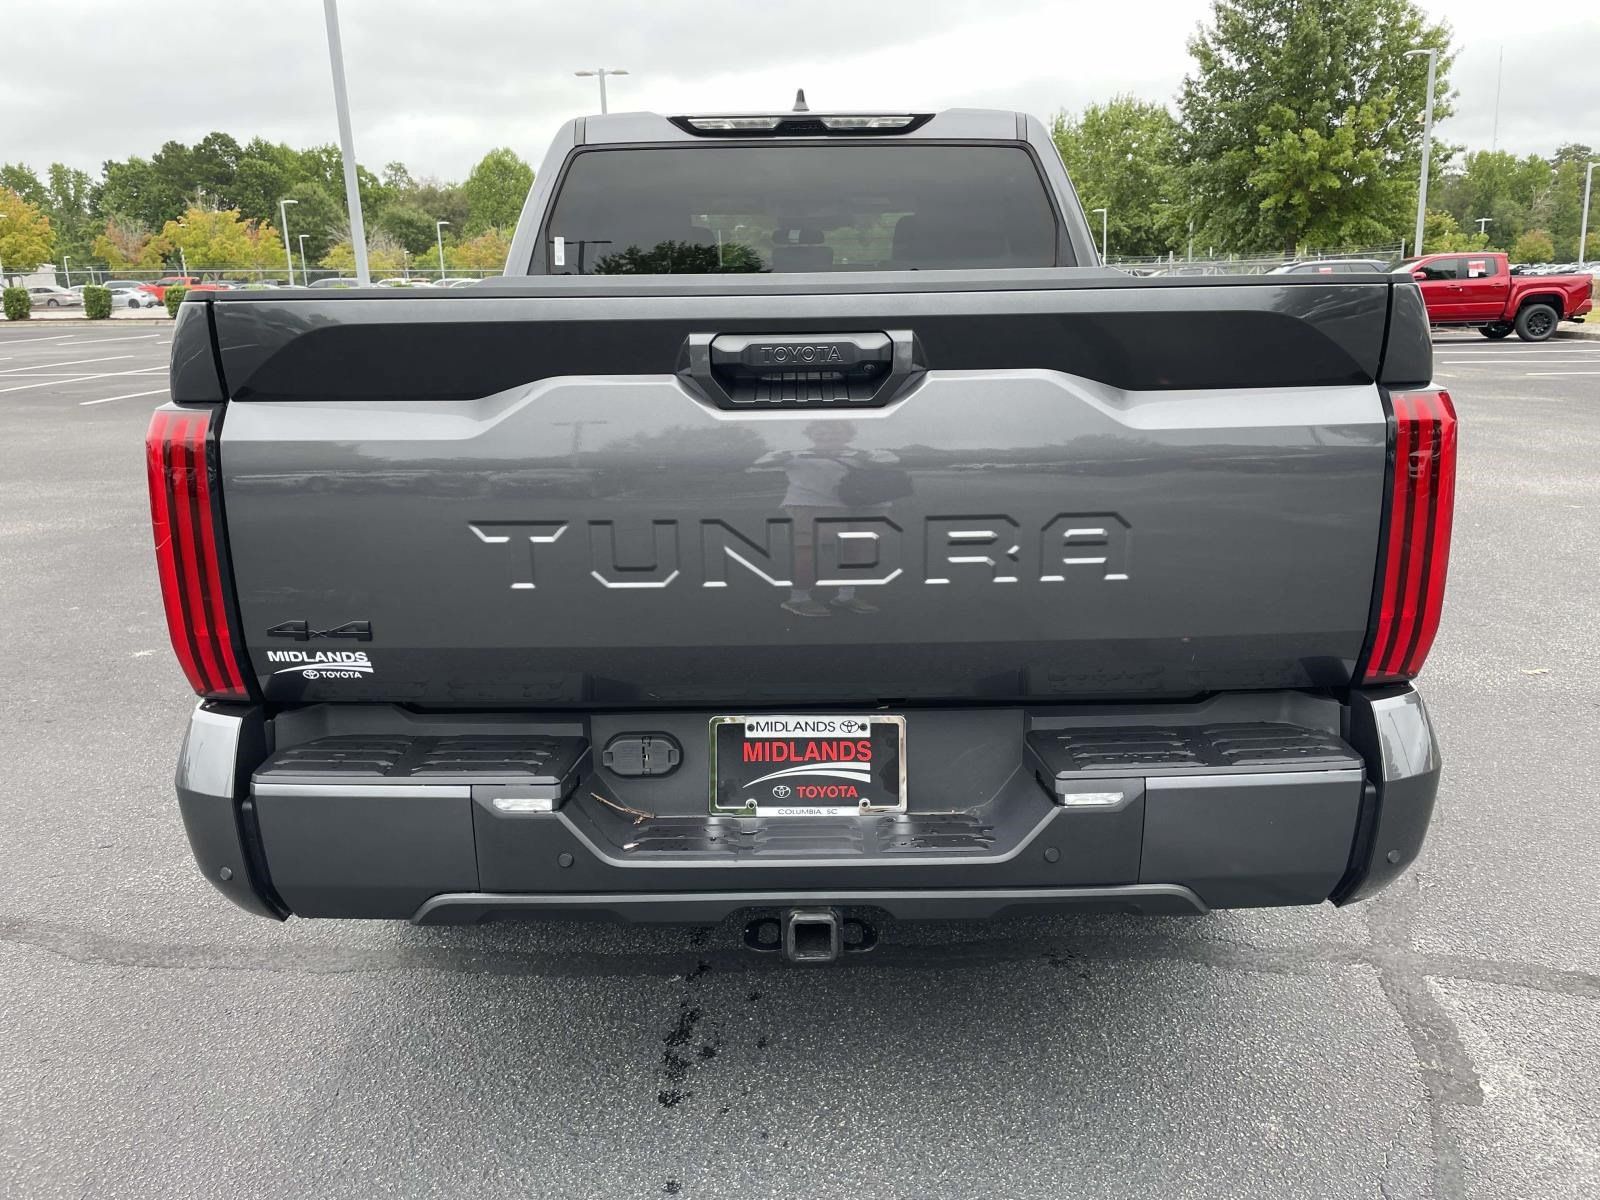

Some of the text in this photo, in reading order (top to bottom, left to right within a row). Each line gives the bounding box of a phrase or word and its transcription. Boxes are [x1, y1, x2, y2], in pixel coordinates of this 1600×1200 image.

[760, 346, 843, 363] TOYOTA
[467, 512, 1132, 590] TUNDRA
[266, 651, 368, 662] MIDLANDS
[320, 671, 363, 679] TOYOTA
[755, 721, 836, 733] MIDLANDS
[743, 740, 873, 762] MIDLANDS
[796, 786, 858, 798] TOYOTA
